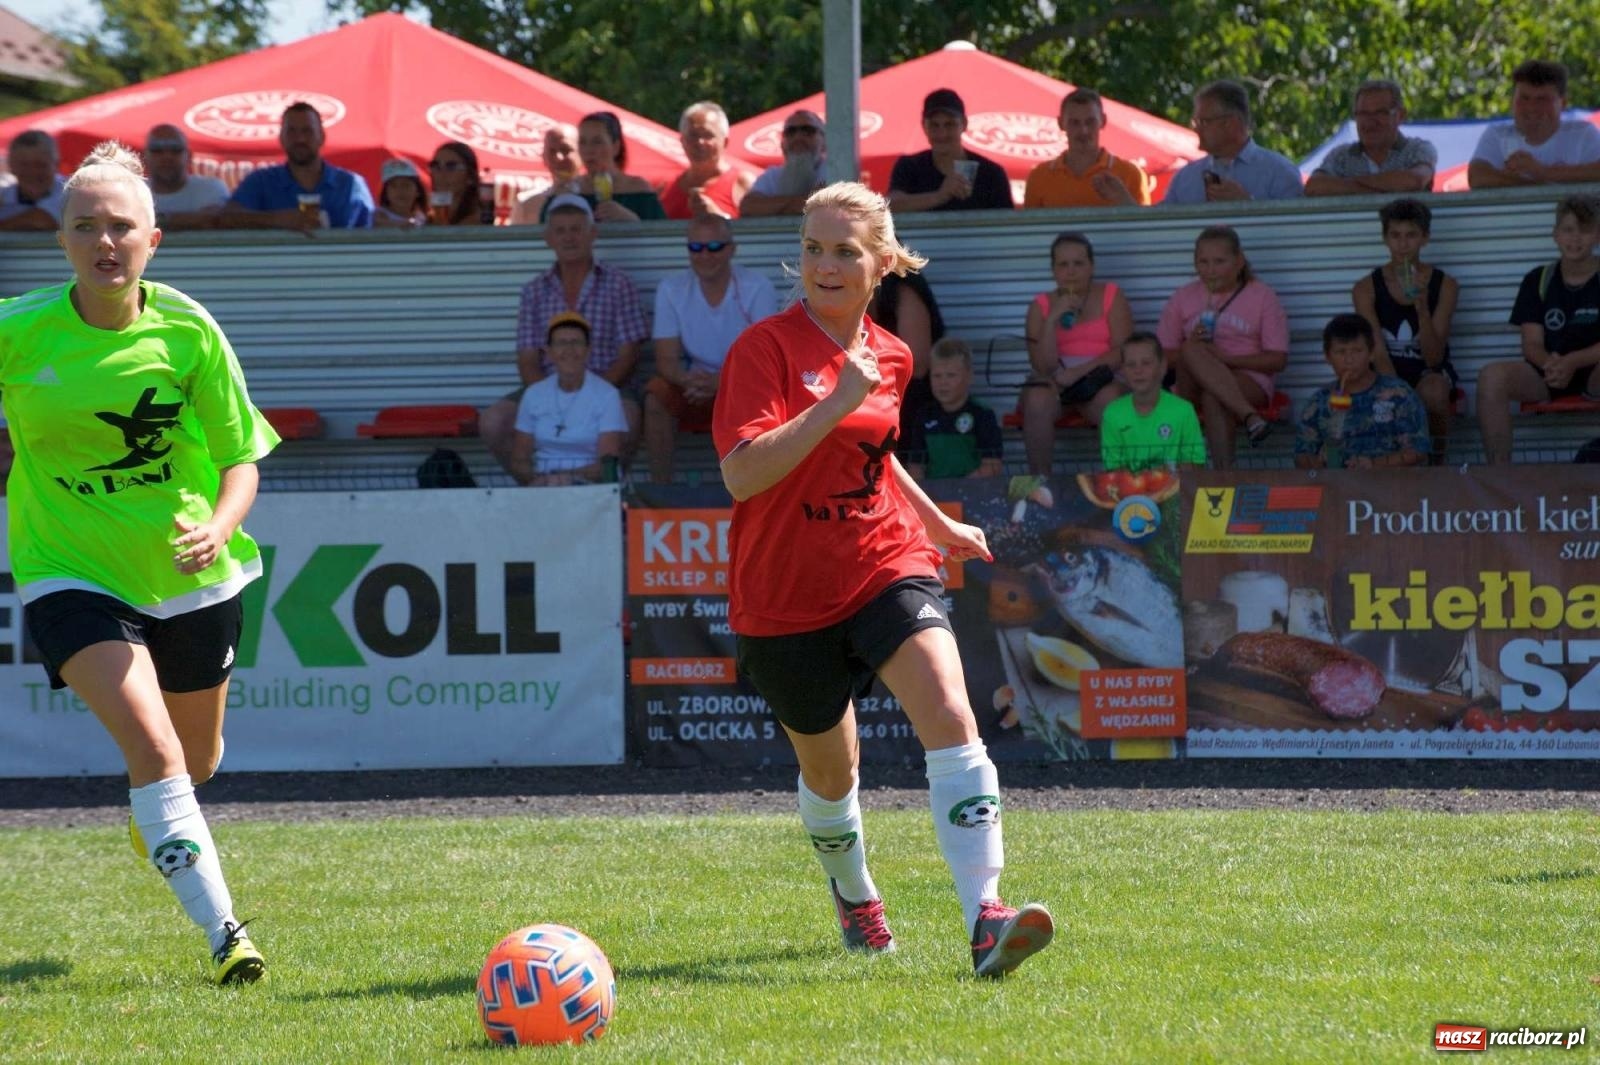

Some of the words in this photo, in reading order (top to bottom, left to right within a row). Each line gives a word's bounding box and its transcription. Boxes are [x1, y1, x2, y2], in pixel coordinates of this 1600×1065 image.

[1347, 498, 1528, 535] Producent
[643, 571, 706, 587] SKLEP
[643, 603, 687, 618] RYBY
[693, 598, 730, 618] ŚWI
[1349, 570, 1600, 631] kiełba
[646, 660, 725, 679] RACIBÓRZ
[1090, 677, 1100, 689] U
[1105, 676, 1133, 689] NAS
[1137, 675, 1174, 688] RYBY
[226, 675, 371, 715] Building
[386, 675, 562, 712] Company
[1095, 696, 1104, 709] Z
[1108, 695, 1175, 708] WŁASNEJ
[647, 701, 673, 715] UL.
[678, 697, 772, 715] ZBOROW
[860, 698, 880, 712] 32
[648, 727, 674, 741] UL.
[679, 722, 757, 740] OCICKA
[763, 722, 776, 740] 5
[1101, 714, 1175, 730] WĘDZARNI
